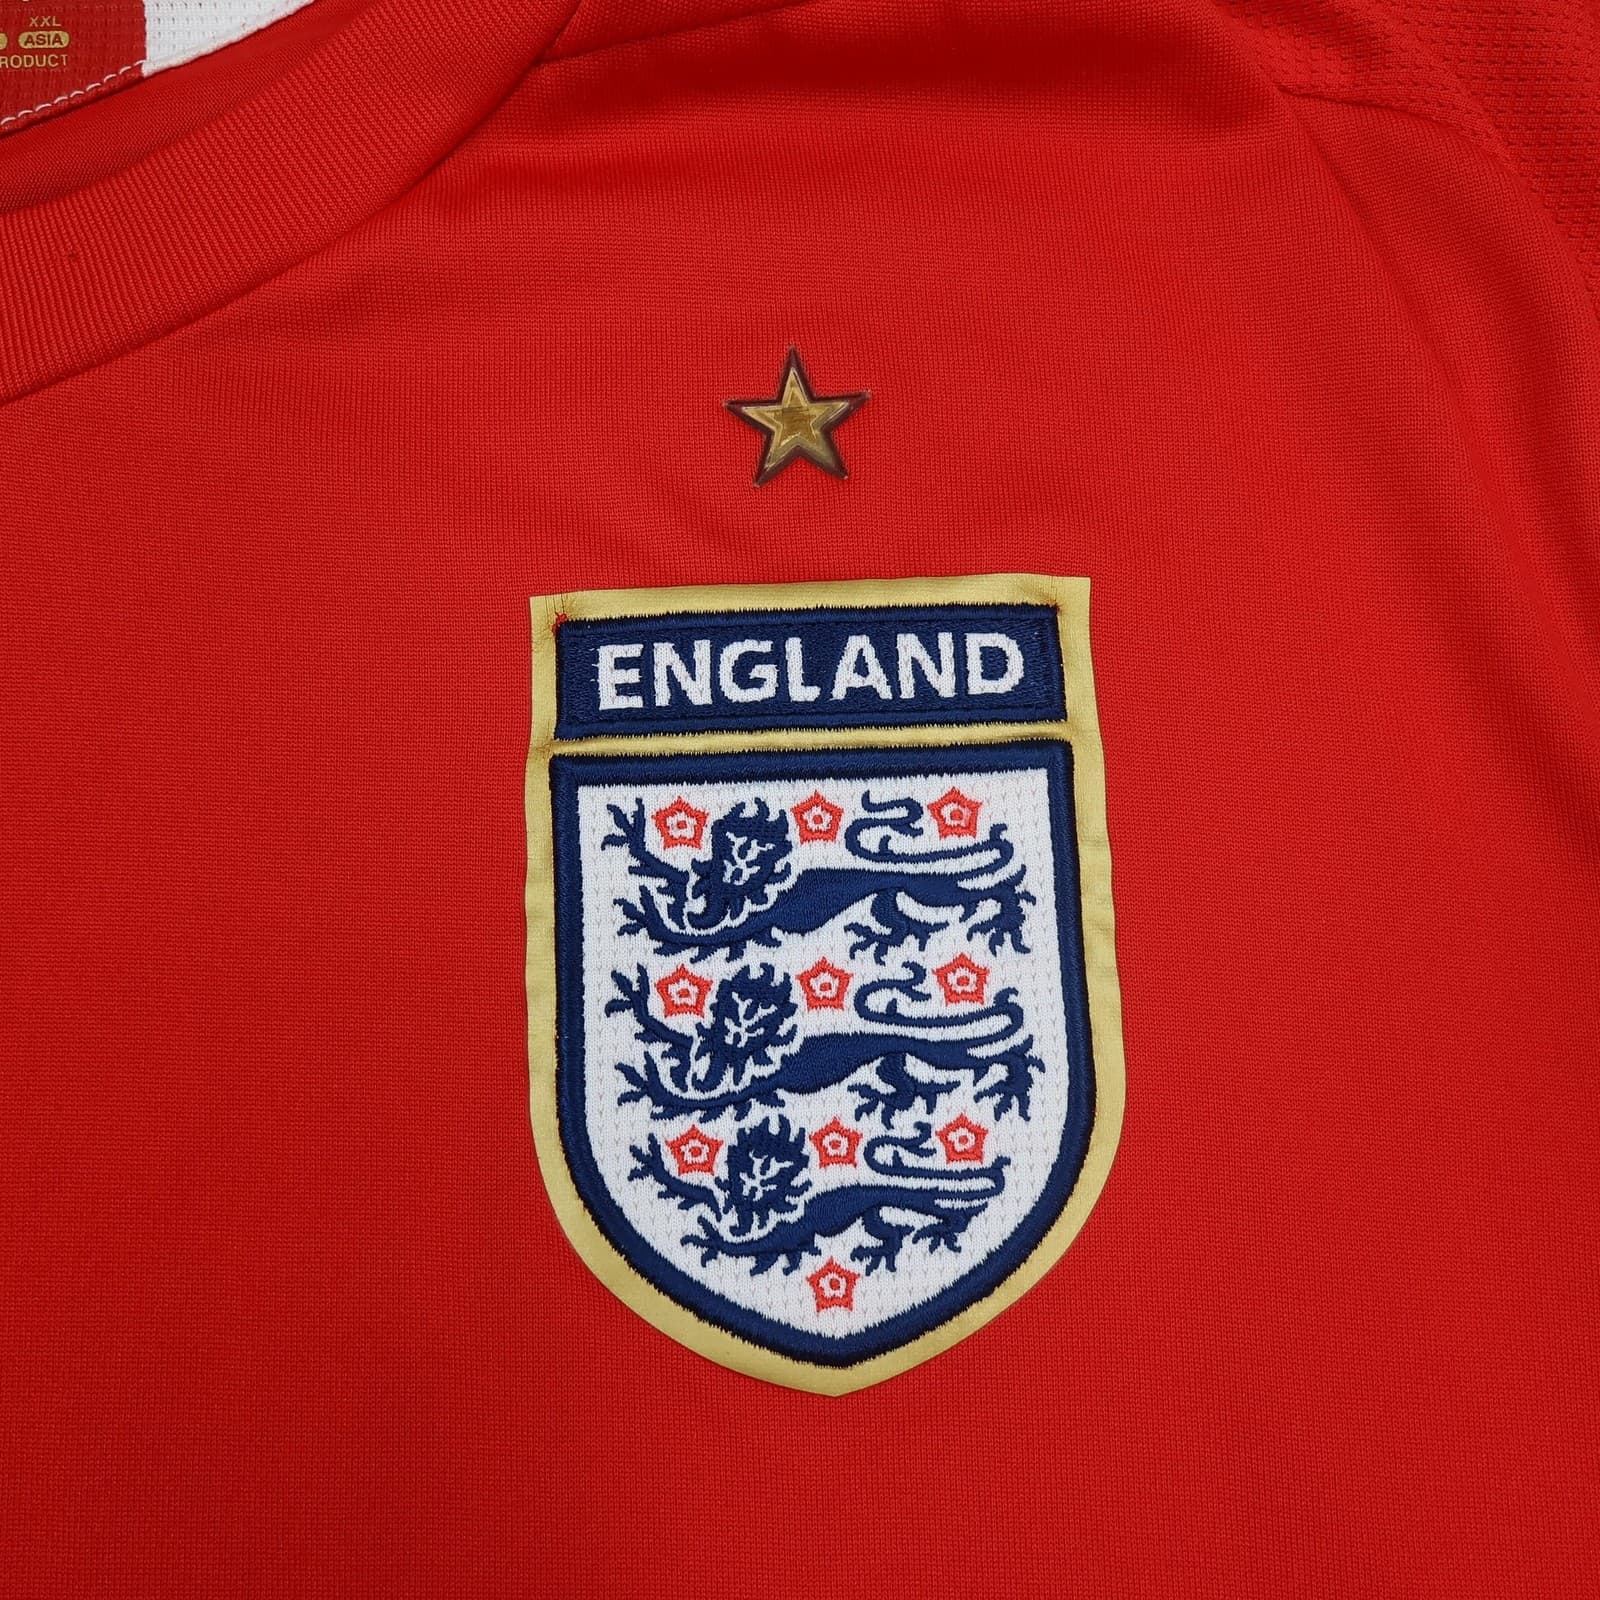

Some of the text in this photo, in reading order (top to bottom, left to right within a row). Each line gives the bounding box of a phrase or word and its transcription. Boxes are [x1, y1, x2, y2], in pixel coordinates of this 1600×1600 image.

[28, 15, 62, 27] XXL
[24, 33, 64, 46] ASIA
[596, 632, 1025, 711] ENGLAND
